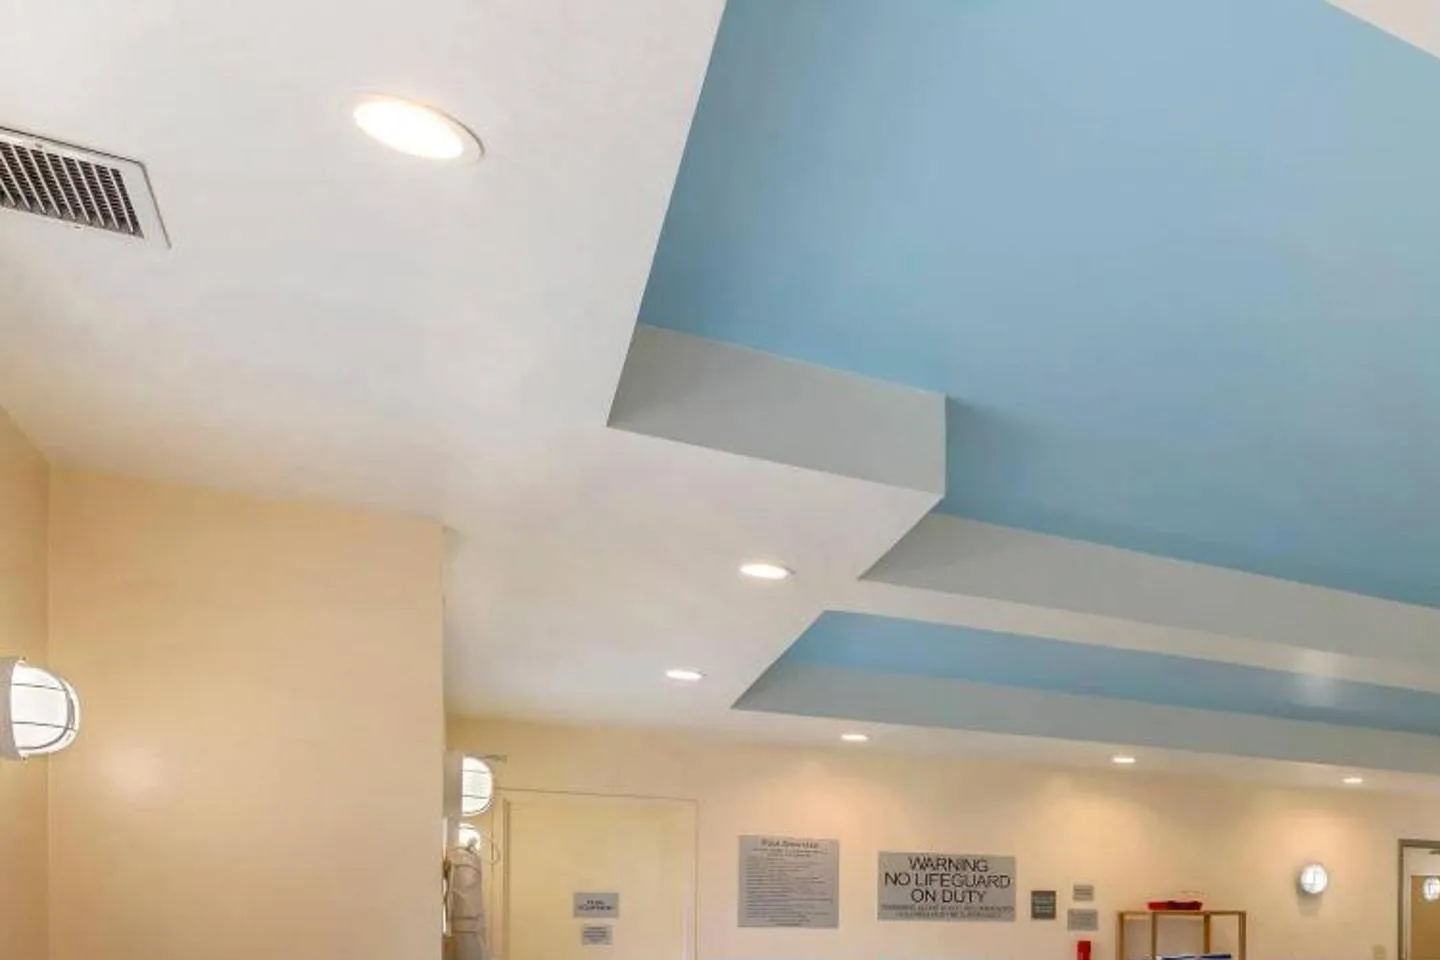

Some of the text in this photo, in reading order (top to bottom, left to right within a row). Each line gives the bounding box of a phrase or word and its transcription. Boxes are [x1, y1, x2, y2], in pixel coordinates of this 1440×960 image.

[908, 857, 988, 872] WARNING
[884, 872, 1010, 888] NO LIFEGUARD
[911, 888, 986, 903] ON DUTY
